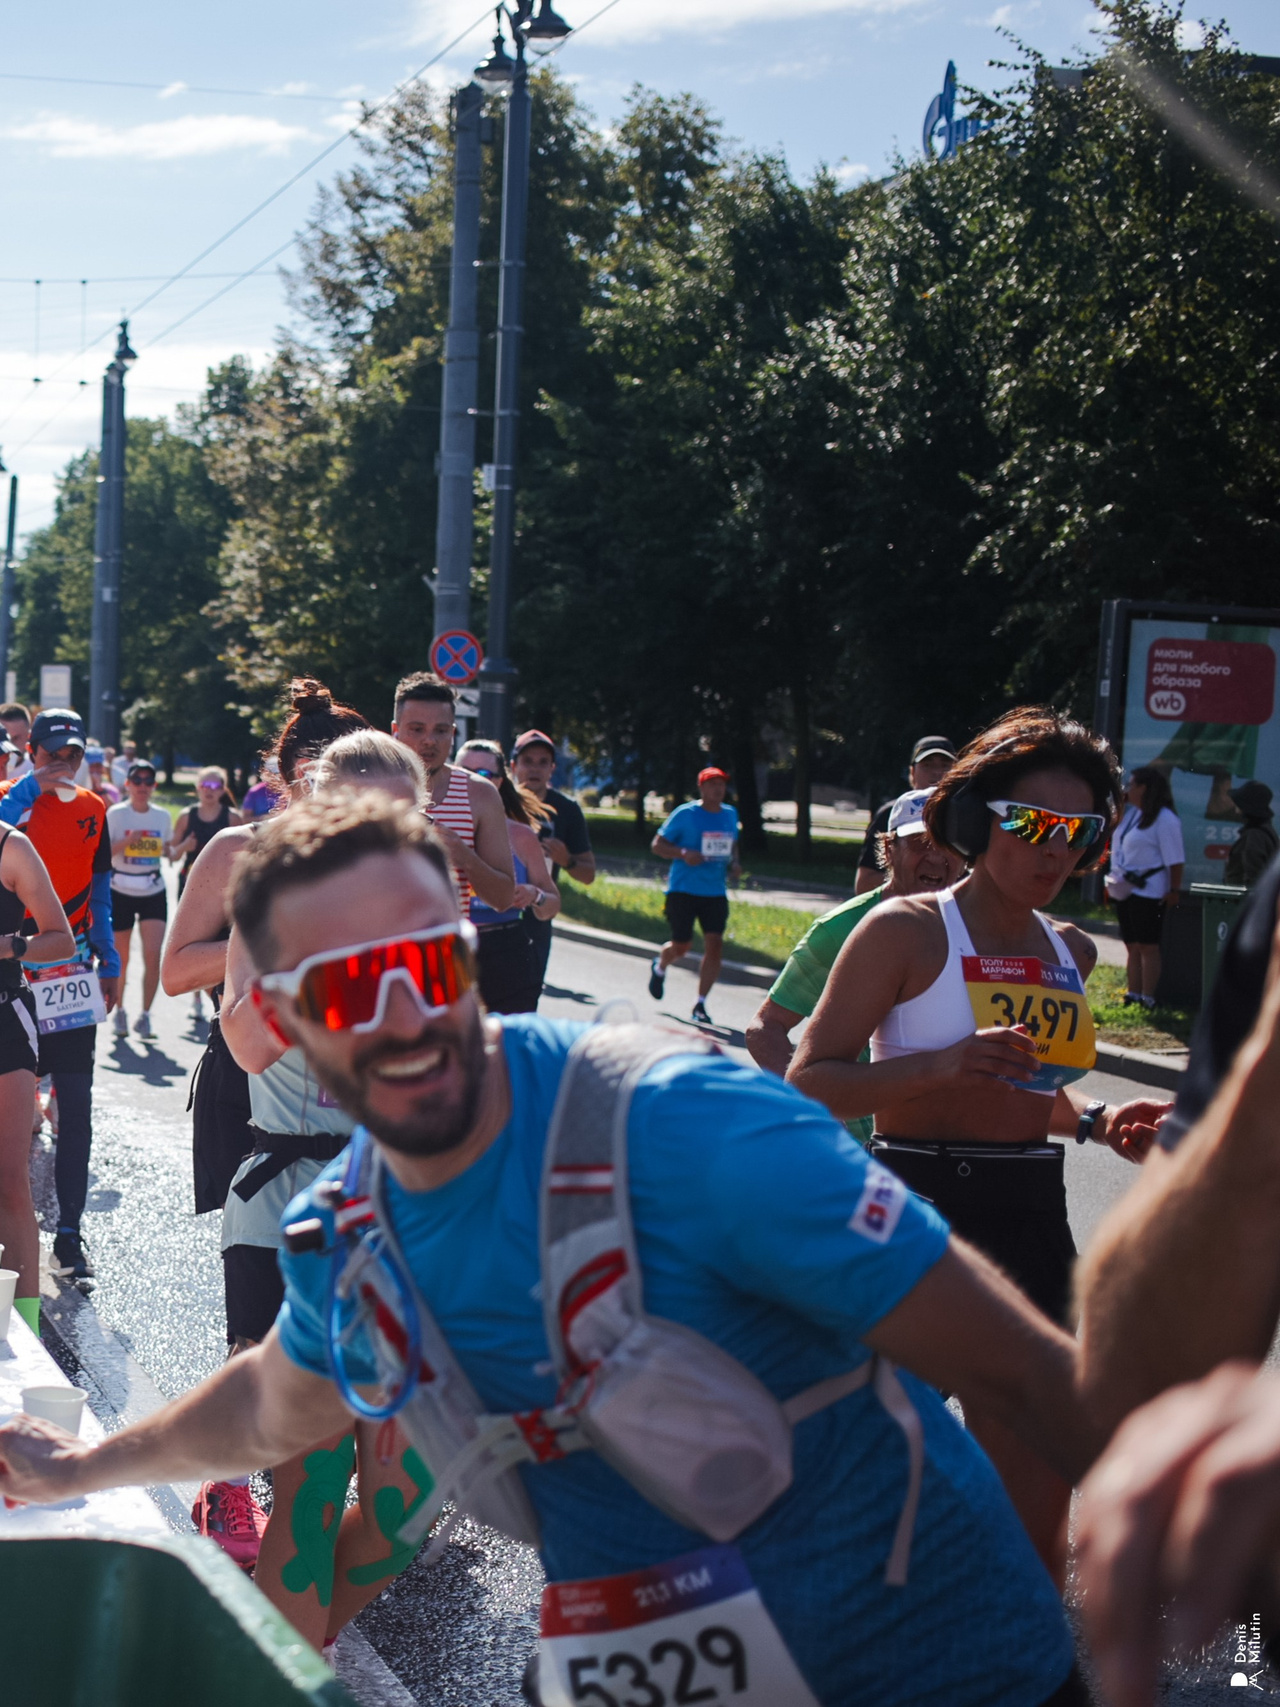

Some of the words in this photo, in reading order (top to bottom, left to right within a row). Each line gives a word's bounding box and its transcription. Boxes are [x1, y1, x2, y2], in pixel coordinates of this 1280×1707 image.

[1154, 649, 1193, 659] мюли
[1153, 662, 1177, 673] для
[1180, 662, 1231, 675] любого
[1152, 674, 1201, 688] образа
[1154, 693, 1181, 711] wb
[980, 958, 1004, 966] ПОЛУ
[981, 966, 1026, 976] МАРАФОН
[42, 980, 91, 1007] 2790
[56, 1001, 84, 1012] БАХТИЕР
[990, 992, 1079, 1042] 3497
[46, 1019, 56, 1030] D
[633, 1581, 671, 1608] 21,1
[568, 1625, 748, 1707] 5329
